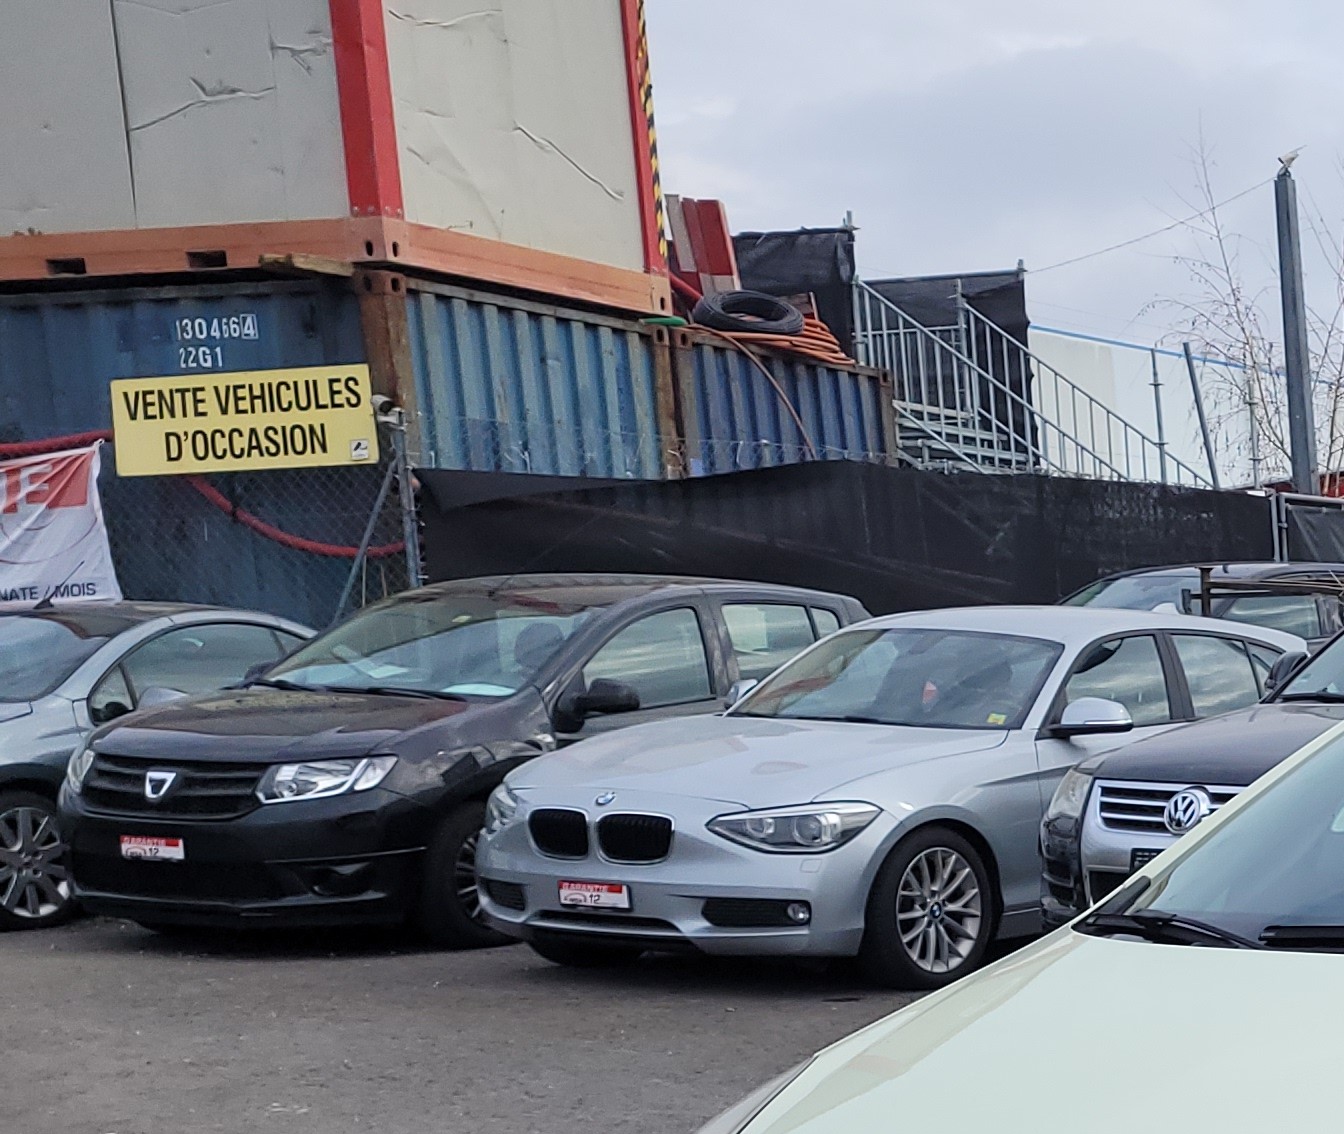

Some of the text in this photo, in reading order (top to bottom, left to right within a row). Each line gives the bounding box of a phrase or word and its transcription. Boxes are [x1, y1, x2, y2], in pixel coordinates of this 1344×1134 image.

[179, 347, 223, 368] 22G1
[122, 376, 362, 422] VENTE VEHICULES
[164, 423, 328, 462] D'OCCASION
[55, 582, 97, 598] MOIS
[589, 894, 601, 904] 12
